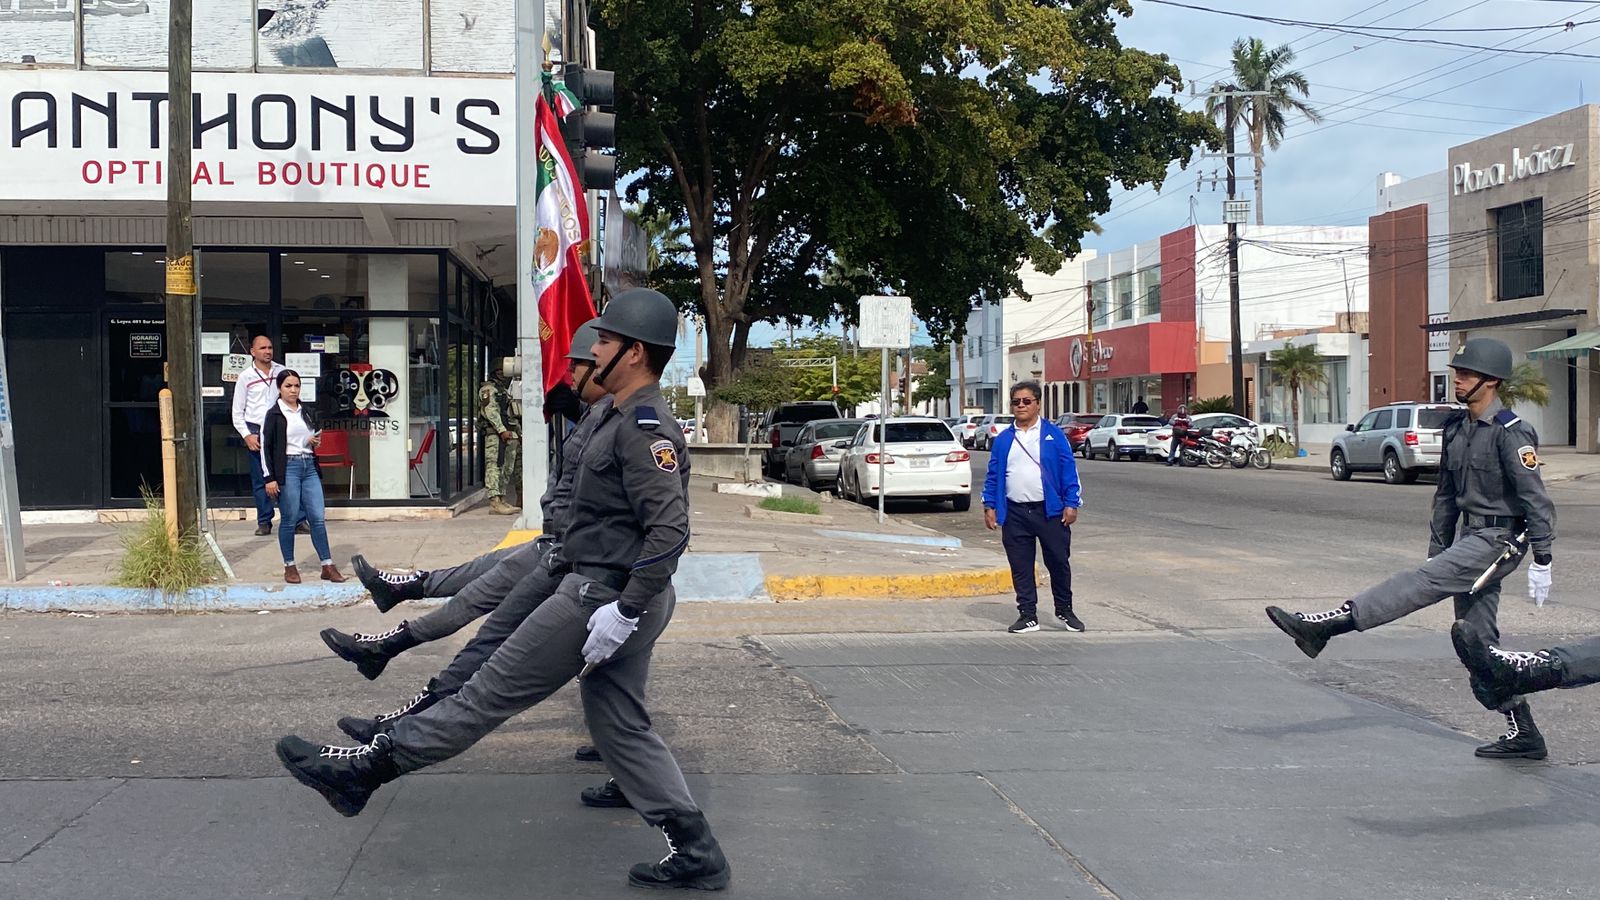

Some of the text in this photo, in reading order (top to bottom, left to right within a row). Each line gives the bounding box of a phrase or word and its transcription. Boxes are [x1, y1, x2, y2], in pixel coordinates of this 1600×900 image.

[11, 91, 500, 154] ANTHONY'S
[81, 159, 431, 189] OPTIAL BOUTIQUE
[1453, 143, 1575, 196] Plaza Juárez
